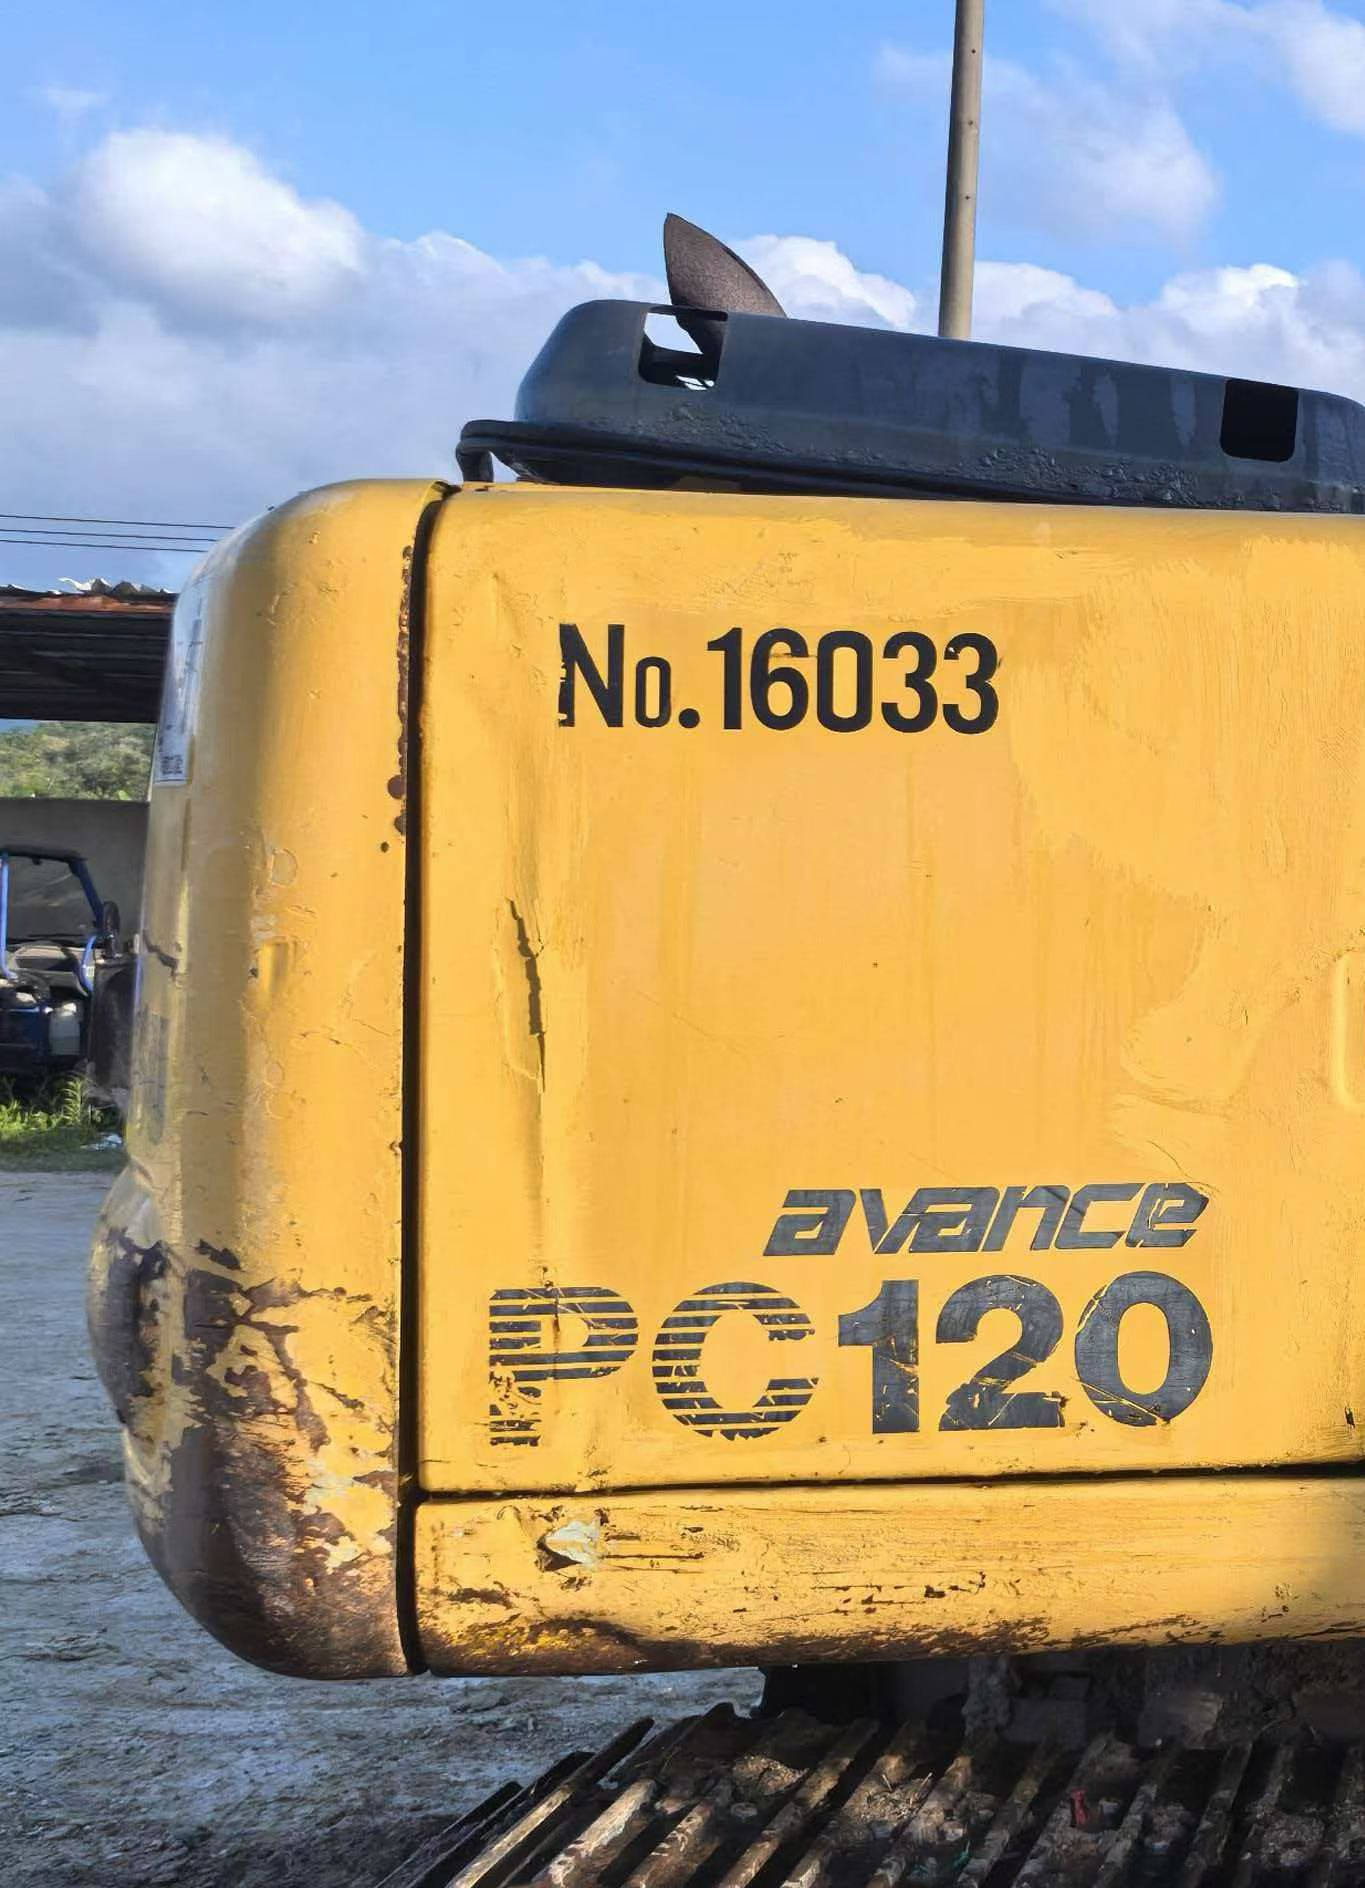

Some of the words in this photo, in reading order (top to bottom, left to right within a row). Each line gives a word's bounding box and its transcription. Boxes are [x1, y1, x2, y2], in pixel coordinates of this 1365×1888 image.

[558, 623, 999, 734] No.16033
[762, 1182, 1210, 1257] avance
[489, 1271, 1213, 1447] PC120
